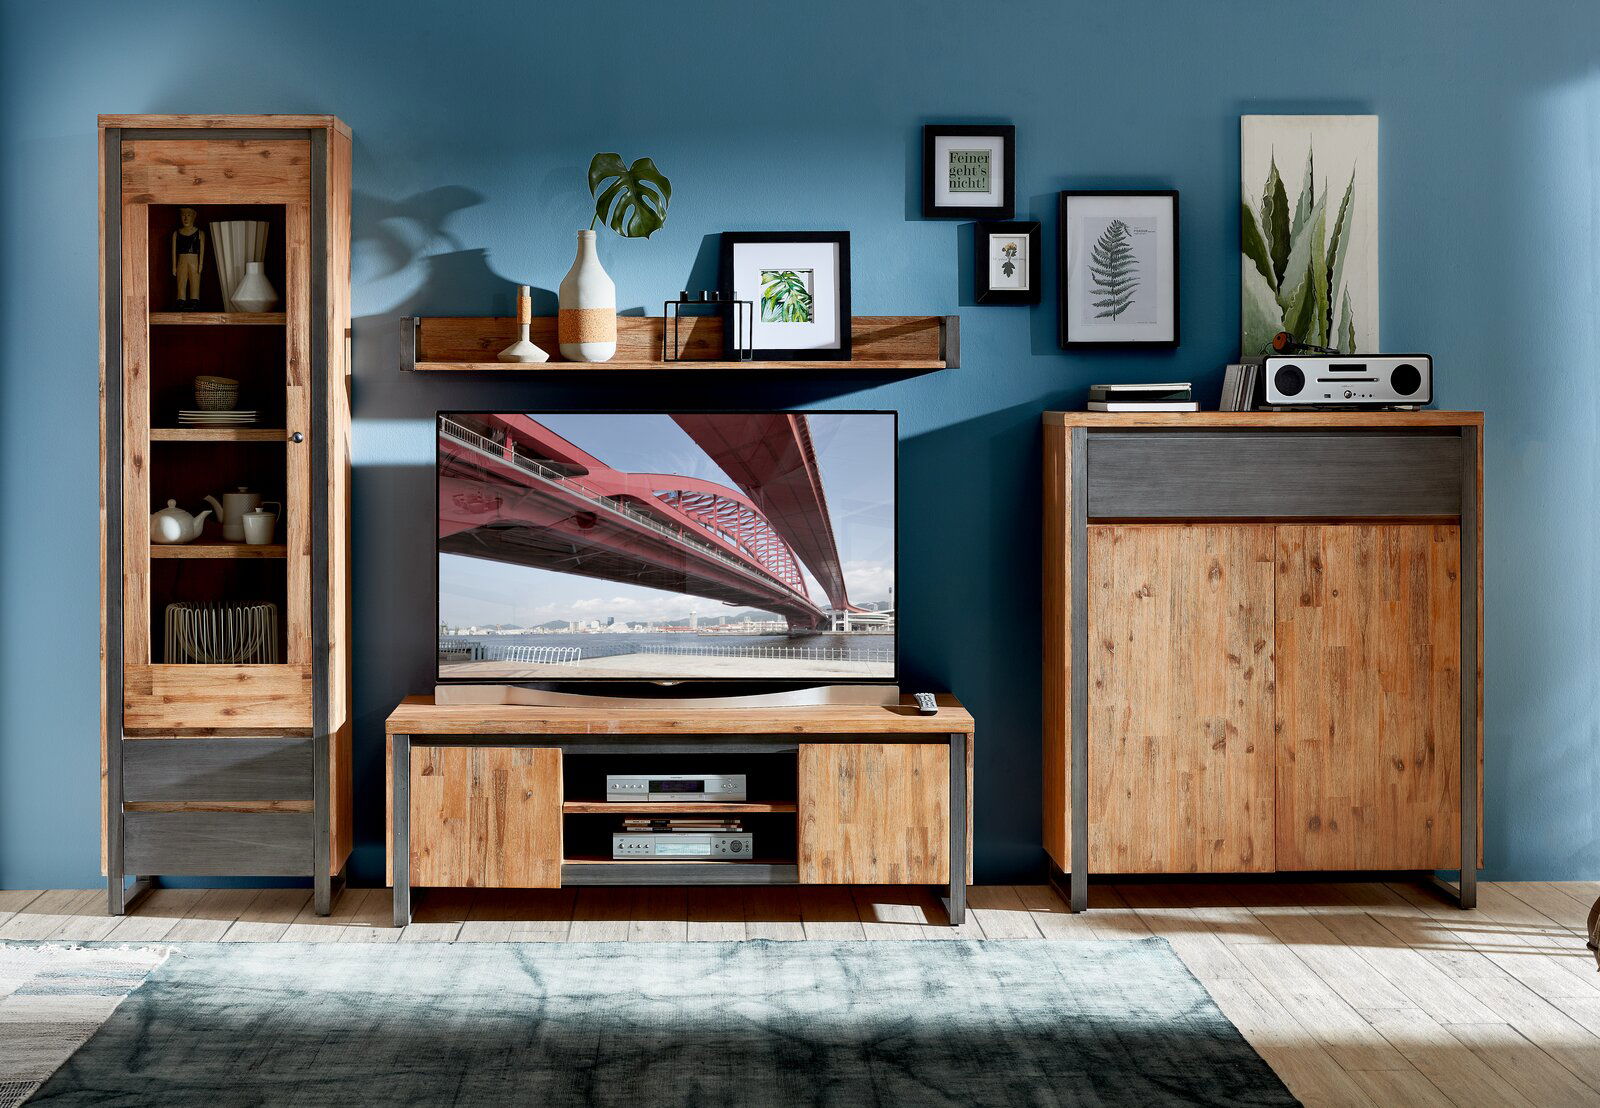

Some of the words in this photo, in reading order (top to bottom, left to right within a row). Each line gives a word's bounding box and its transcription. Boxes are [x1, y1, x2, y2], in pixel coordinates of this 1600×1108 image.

[950, 152, 989, 163] Feiner
[949, 164, 987, 179] geht's
[949, 177, 985, 188] nicht!
